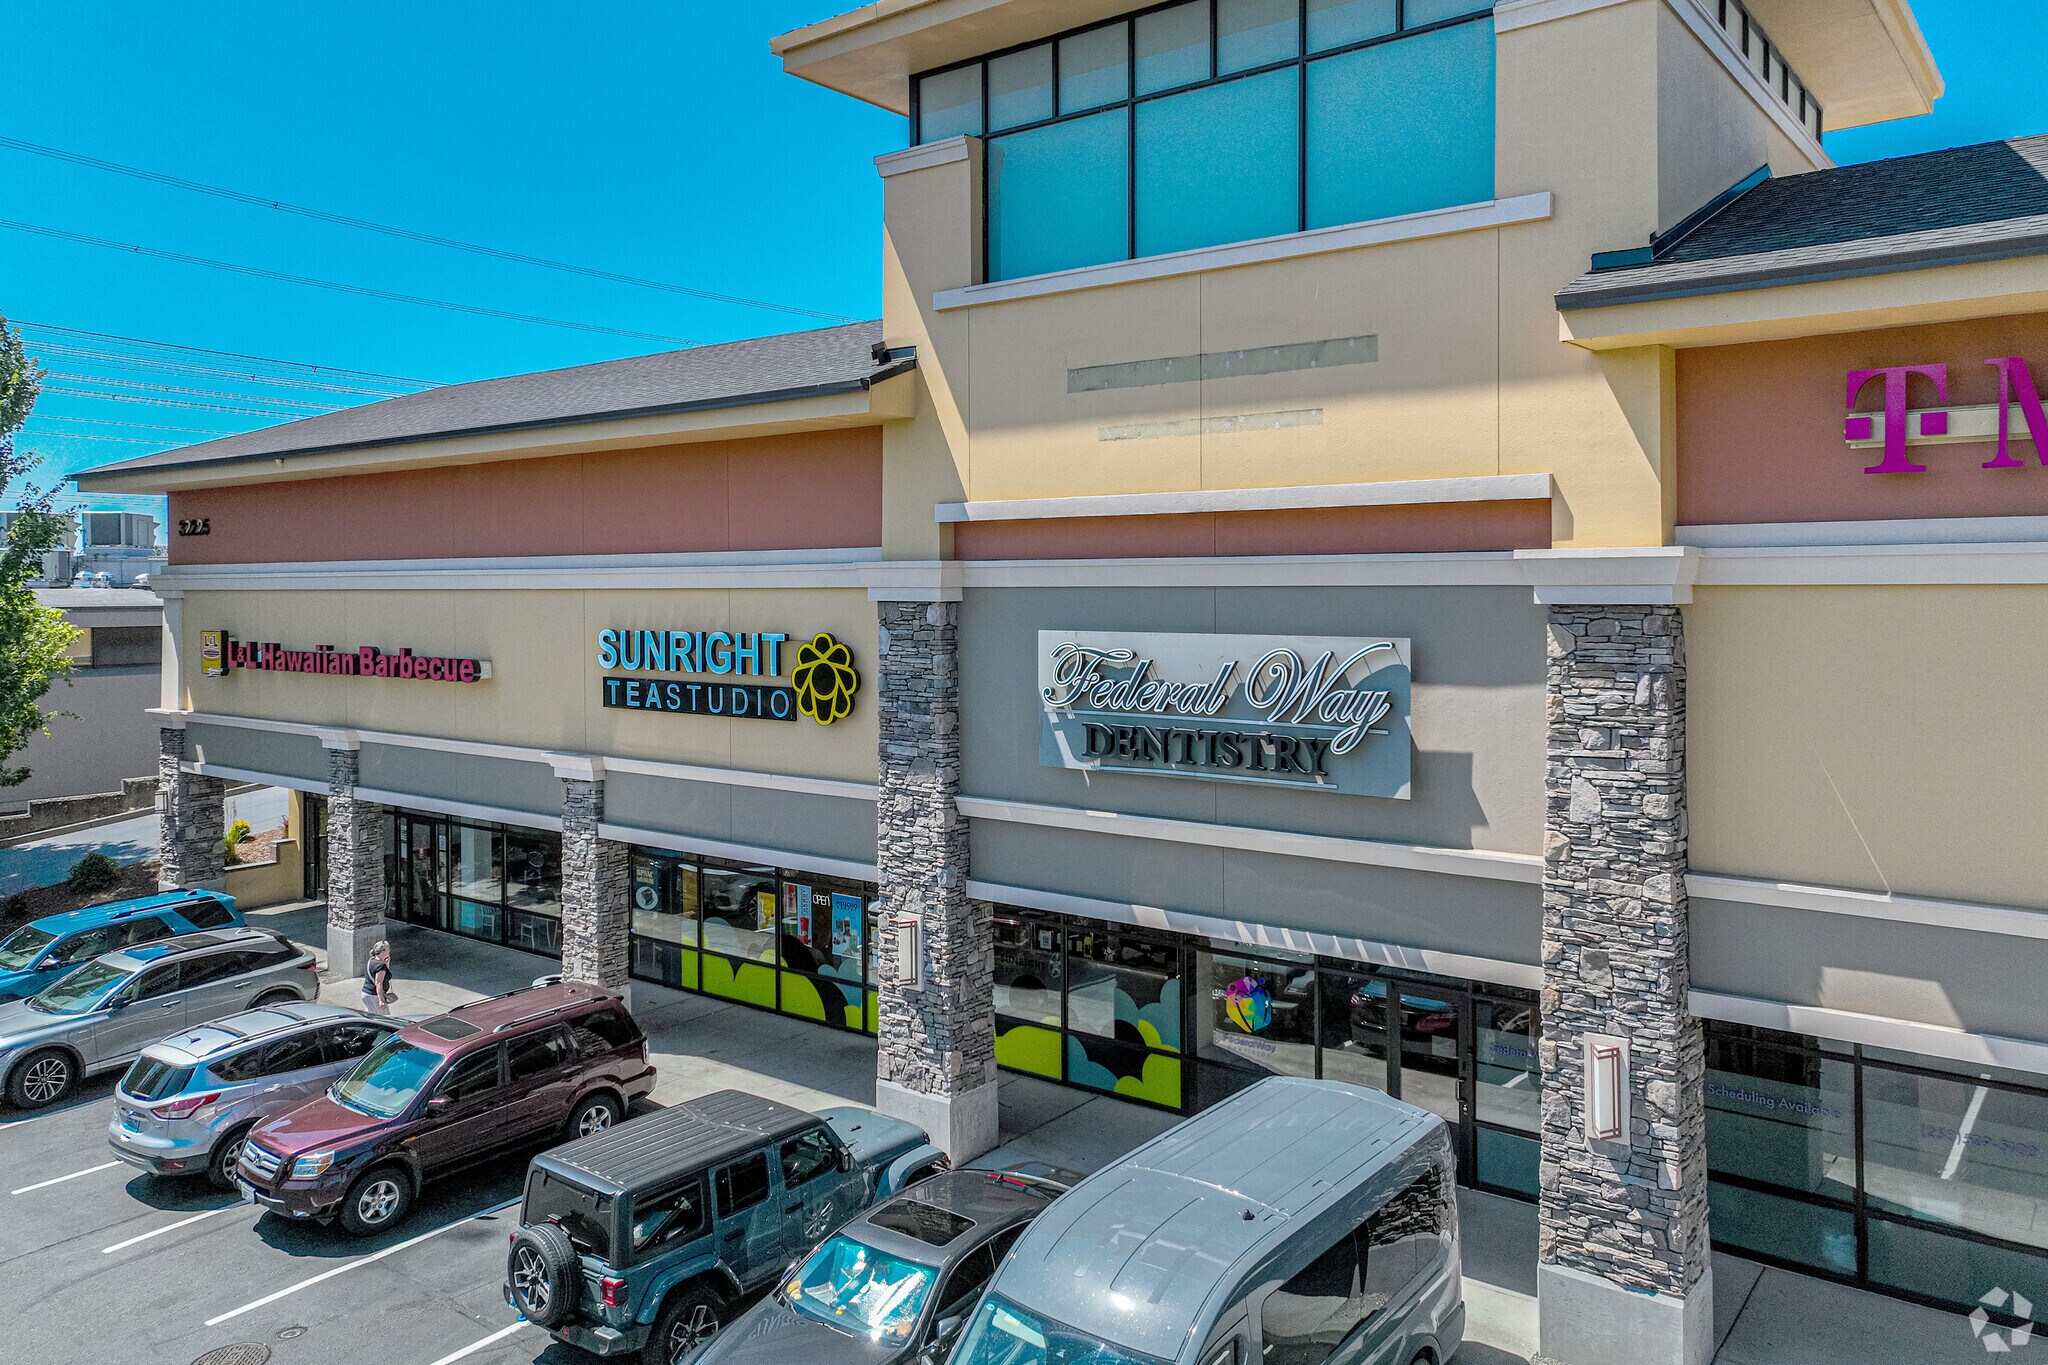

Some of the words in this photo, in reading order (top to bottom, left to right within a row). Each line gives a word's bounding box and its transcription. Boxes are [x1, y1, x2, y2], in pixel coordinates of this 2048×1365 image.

[227, 640, 257, 670] L&L
[261, 642, 354, 676] Hawaiian
[359, 646, 475, 684] Barbecue
[597, 628, 788, 677] SUNRIGHT
[1043, 641, 1239, 715] Federal
[1245, 641, 1395, 756] Way
[1081, 721, 1333, 776] DENTISTRY
[812, 893, 831, 907] OPEN
[1000, 954, 1046, 971] SUNRIGHT
[1707, 1083, 1776, 1109] Scheduling
[1778, 1097, 1841, 1118] Available
